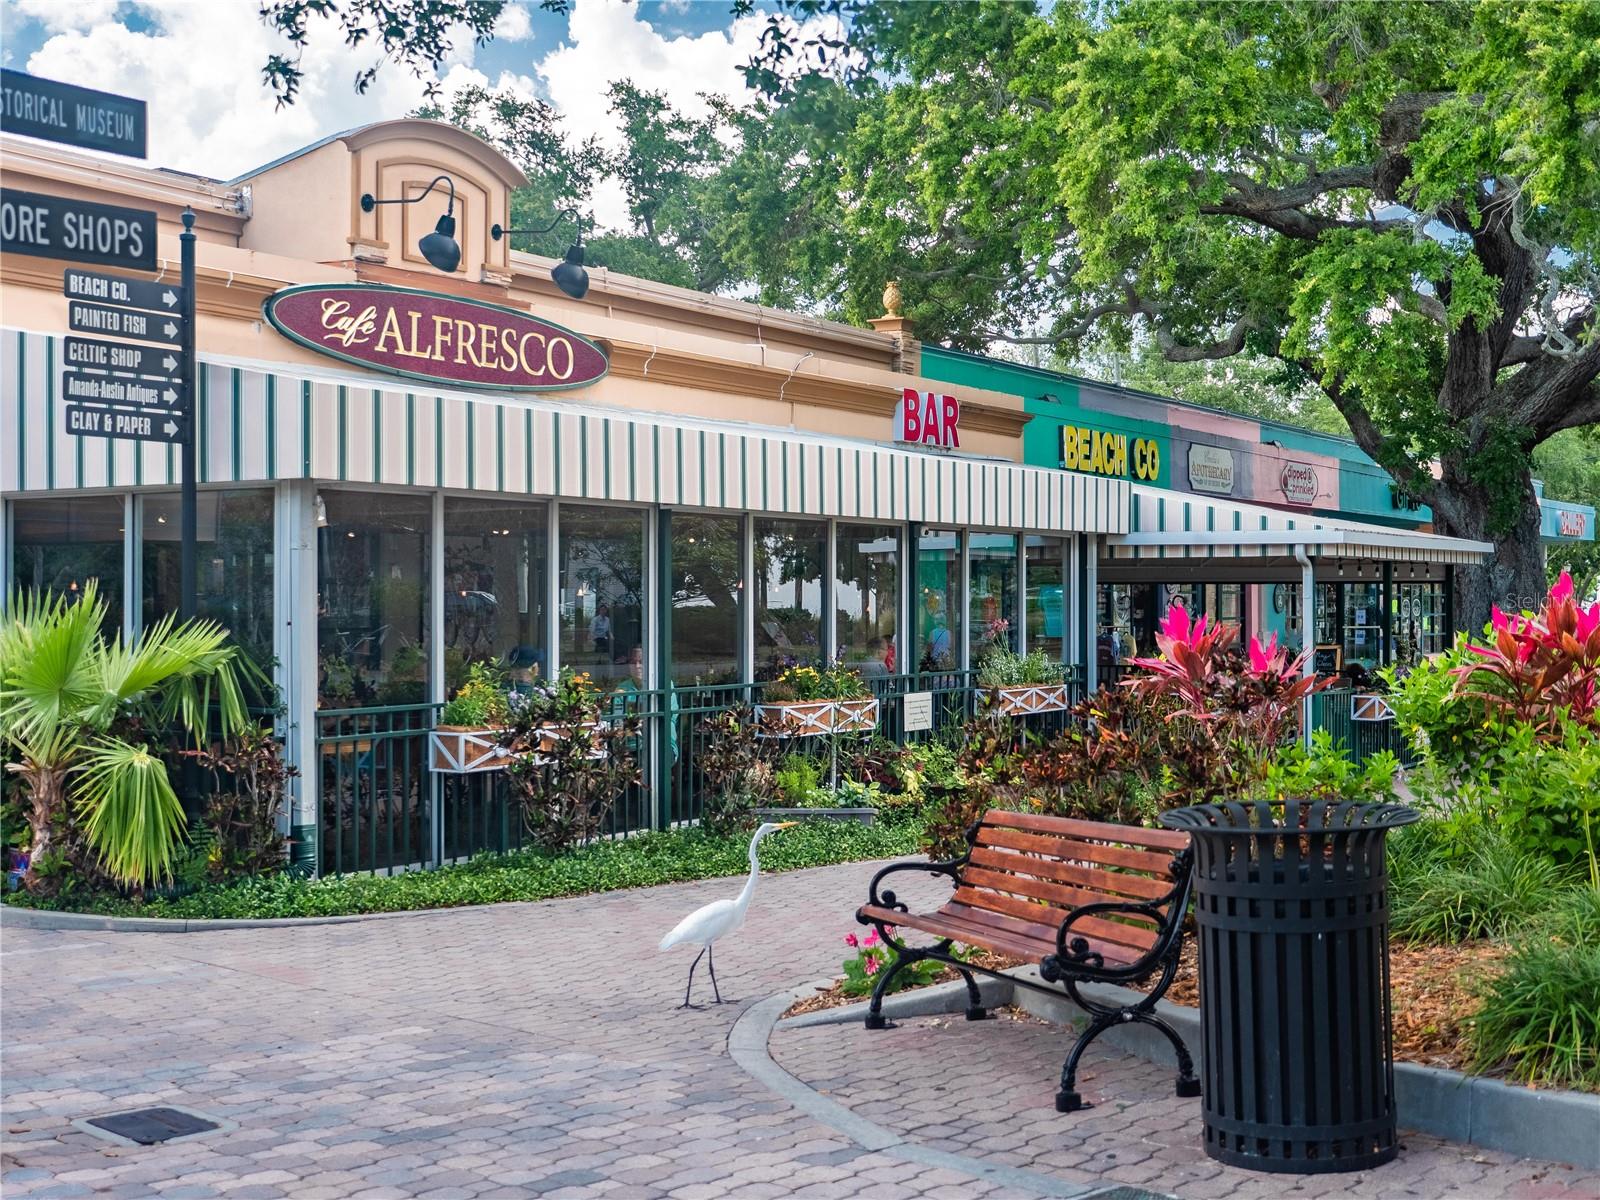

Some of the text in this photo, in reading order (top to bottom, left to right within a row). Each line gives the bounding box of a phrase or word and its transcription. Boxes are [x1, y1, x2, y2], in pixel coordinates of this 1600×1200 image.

[76, 103, 134, 141] MUSEUM
[1, 202, 143, 257] ORE SHOPS
[69, 274, 131, 301] BEACH CO.
[74, 306, 146, 335] PAINTED FISH
[69, 342, 142, 368] CELTIC SHOP
[374, 306, 575, 380] ALFRESCO
[68, 377, 159, 405] Amanda-Austin Antiques
[71, 411, 151, 435] CLAY & PAPER
[903, 387, 961, 448] BAR
[1062, 424, 1160, 481] BEACH CO
